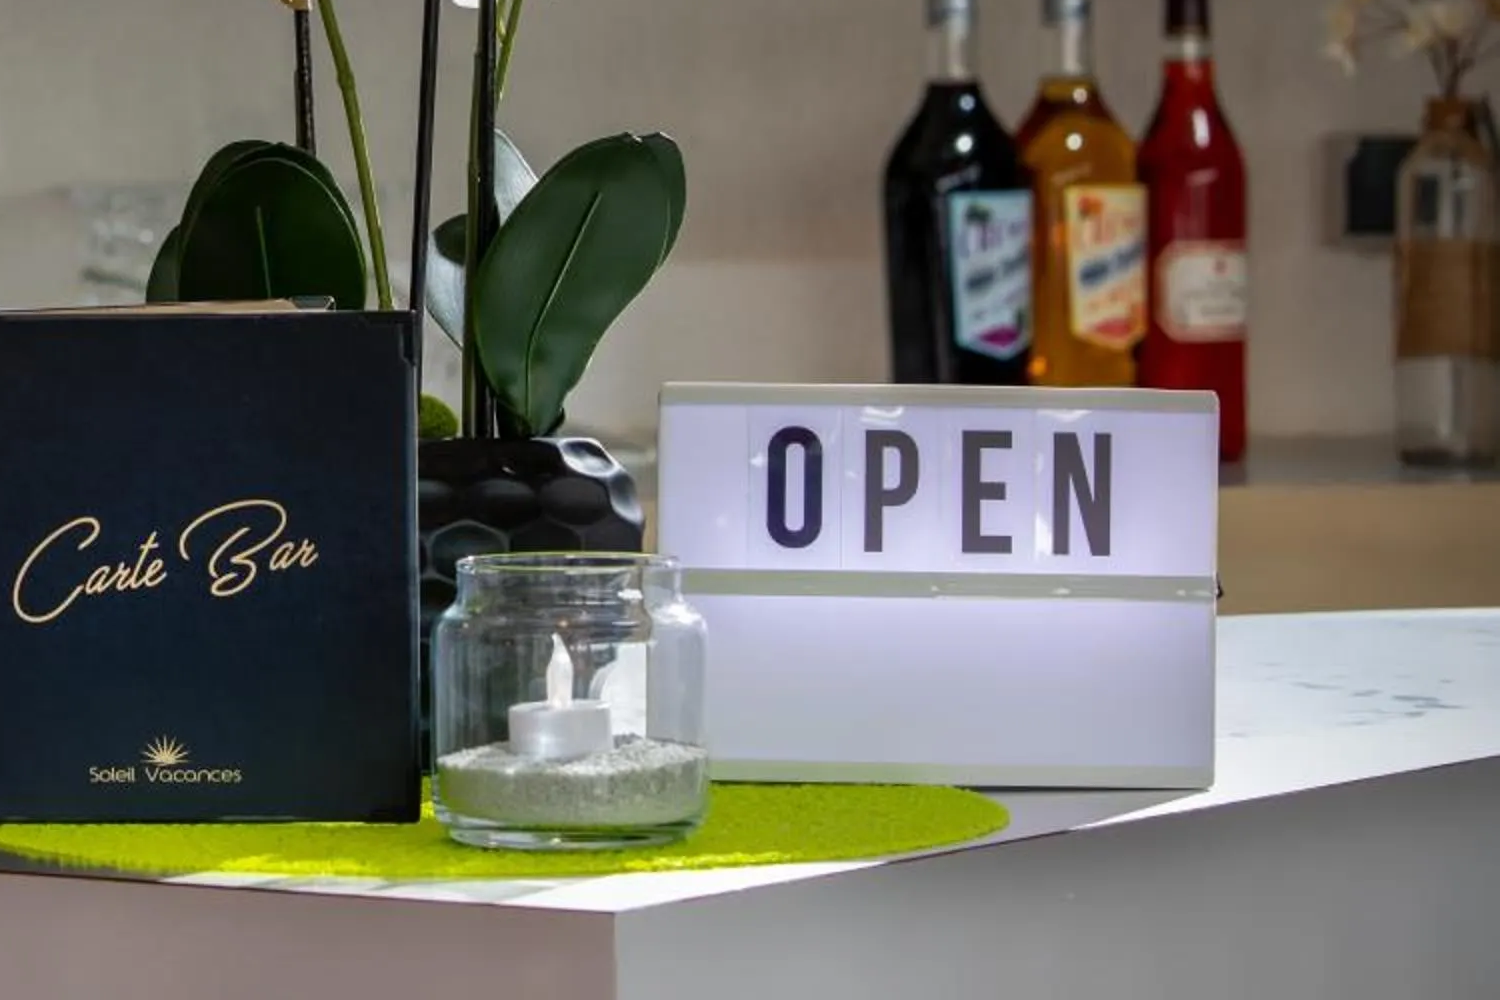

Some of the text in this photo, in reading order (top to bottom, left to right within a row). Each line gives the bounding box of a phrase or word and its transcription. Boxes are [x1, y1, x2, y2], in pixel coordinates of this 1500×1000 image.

[766, 425, 1112, 556] OPEN
[13, 499, 319, 623] Carte Bar
[89, 766, 243, 784] Soleil Vacances
